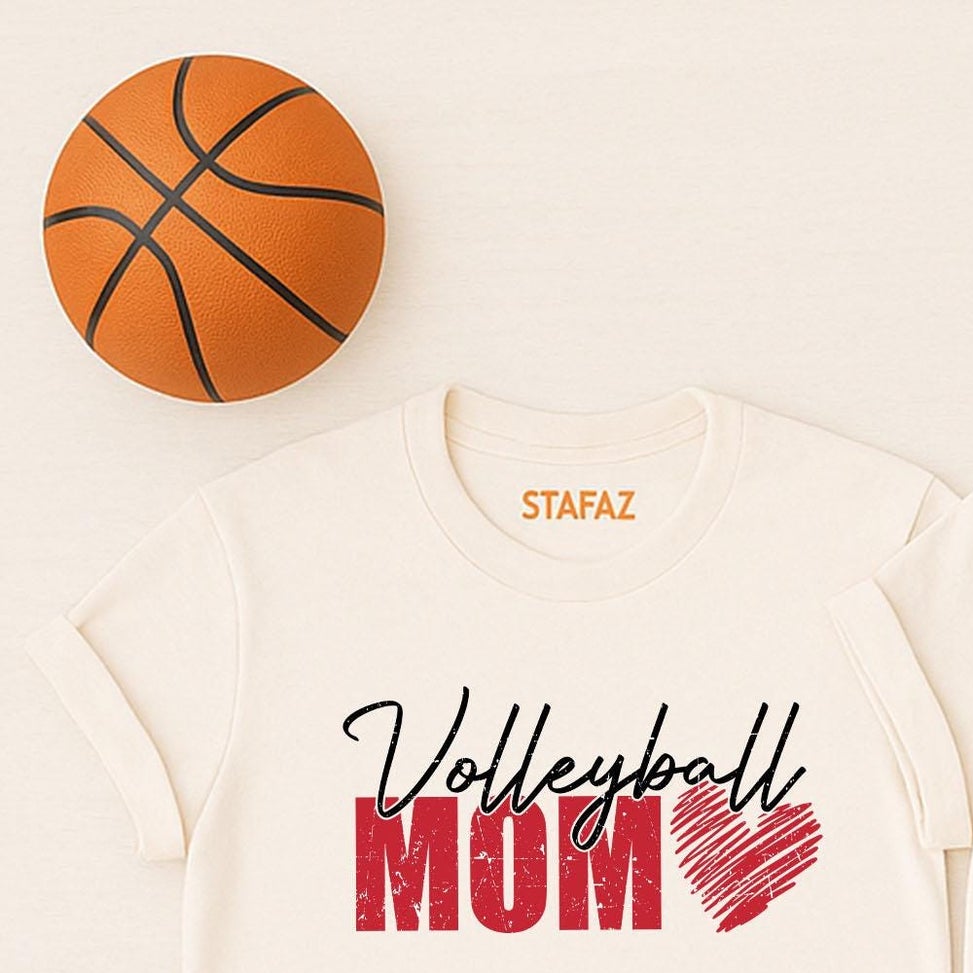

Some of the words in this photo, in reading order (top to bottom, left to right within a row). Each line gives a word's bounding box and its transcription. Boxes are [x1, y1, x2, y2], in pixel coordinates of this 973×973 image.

[522, 490, 636, 521] STAFAZ
[343, 686, 807, 851] Volleyball
[355, 794, 662, 934] MOM
